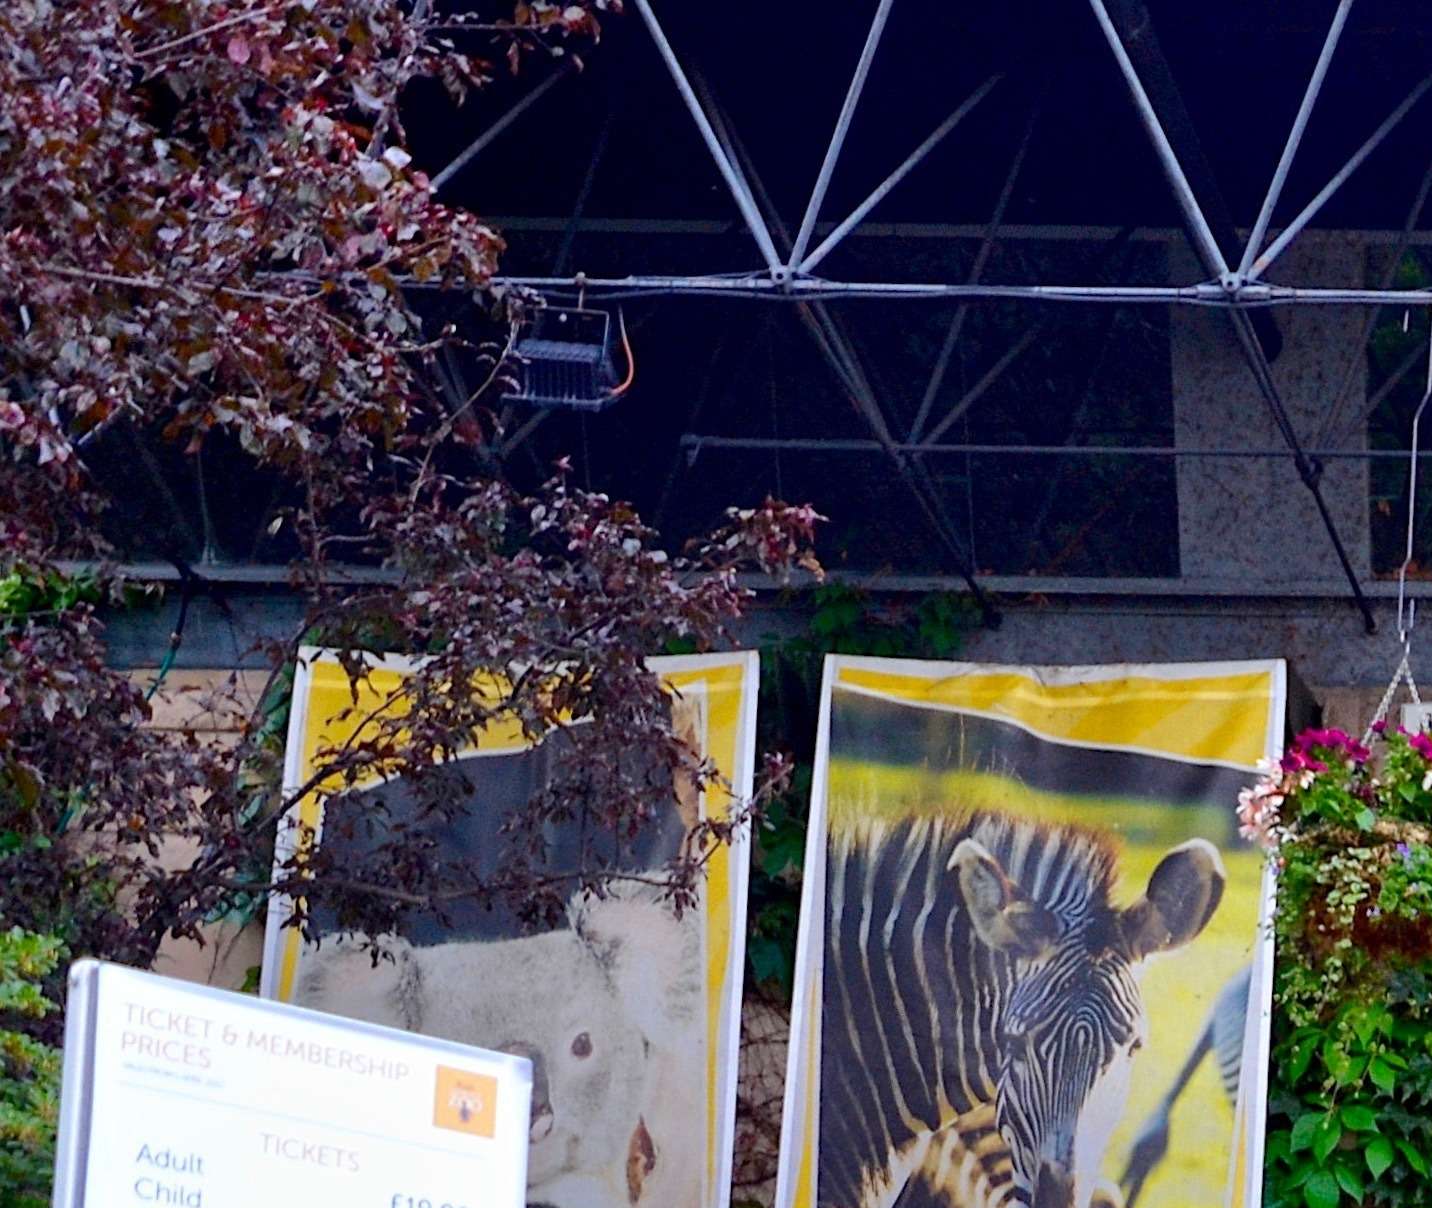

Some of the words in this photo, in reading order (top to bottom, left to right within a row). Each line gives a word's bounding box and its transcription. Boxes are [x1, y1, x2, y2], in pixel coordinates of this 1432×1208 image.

[121, 1031, 212, 1069] PRICES
[125, 1001, 215, 1038] TICKET
[222, 1024, 238, 1046] &
[246, 1030, 410, 1081] MEMBERSHIP
[136, 1144, 204, 1175] Adult
[260, 1132, 360, 1173] TICKETS
[135, 1177, 202, 1208] Child
